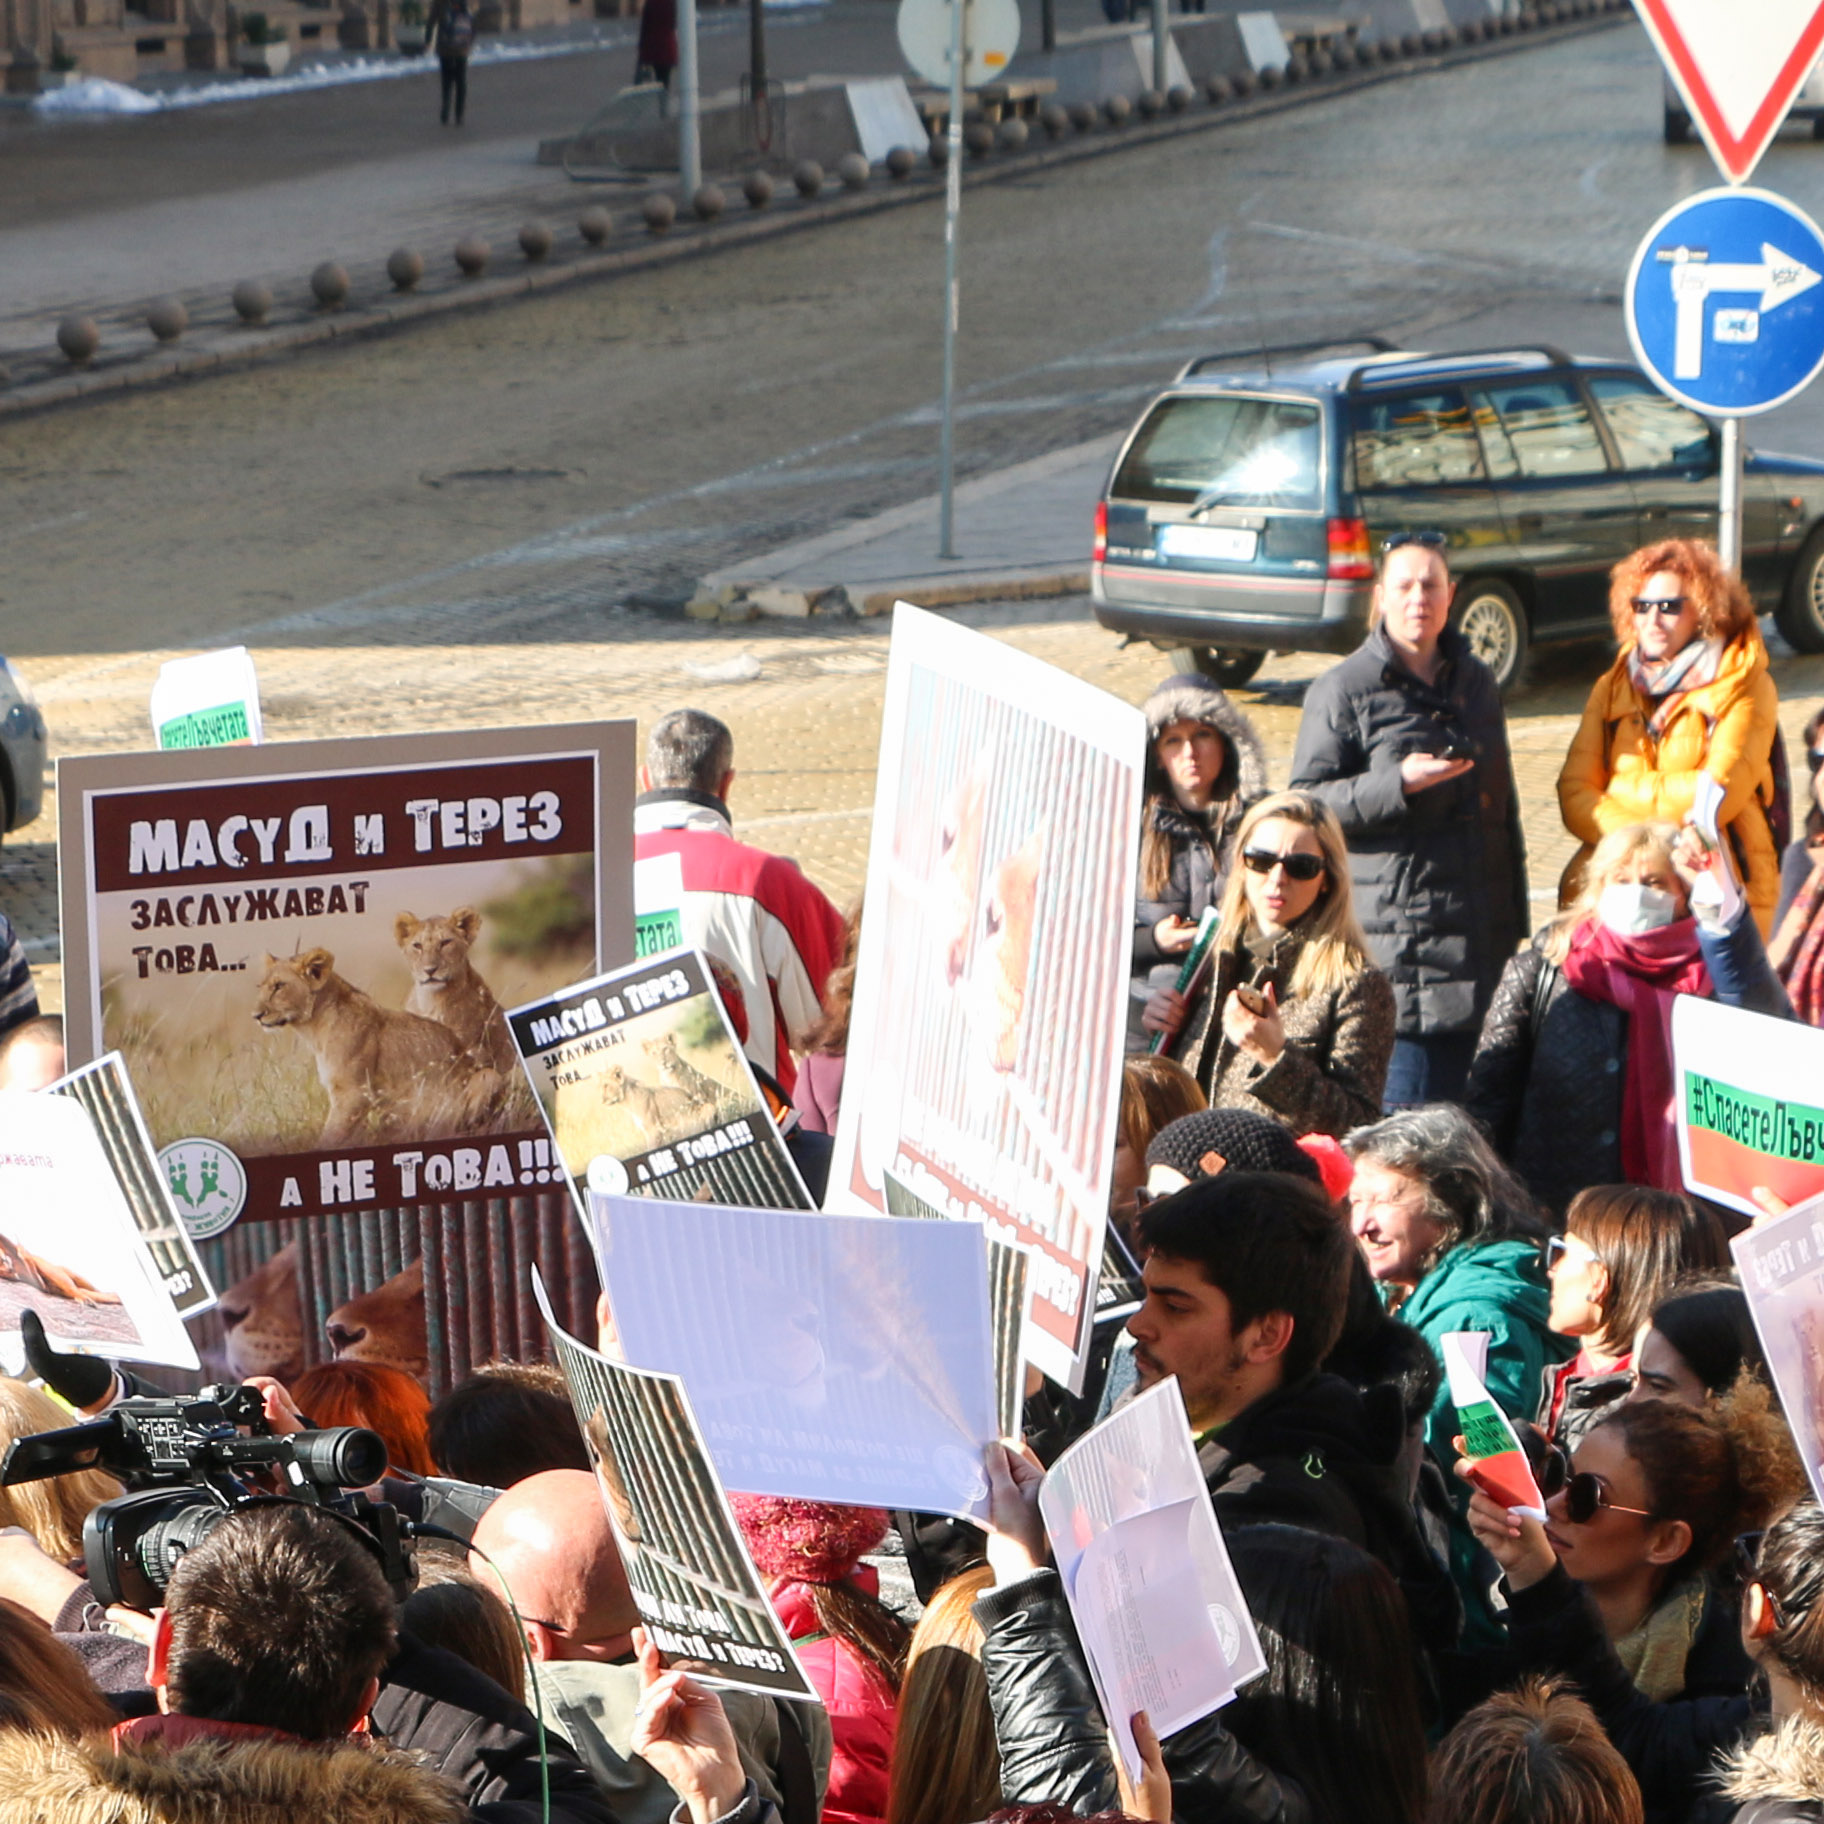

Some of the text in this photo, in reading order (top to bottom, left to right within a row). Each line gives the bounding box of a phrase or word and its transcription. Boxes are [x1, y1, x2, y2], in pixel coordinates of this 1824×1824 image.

[129, 804, 333, 876] МАСУД
[405, 790, 562, 856] ТЕРЕЗ
[130, 881, 371, 932] ЗАСЛУЖАВАТ
[131, 943, 247, 980] ТОВА...
[529, 998, 607, 1047] МАСУД
[623, 969, 691, 1014] ТЕРЕЗ
[542, 1029, 626, 1071] ЗАСЛУЖАВАТ
[647, 1150, 679, 1178] НЕ
[676, 1118, 755, 1168] ТОВА!!!
[319, 1158, 377, 1206] НЕ
[651, 1624, 714, 1661] МАСУД
[723, 1640, 787, 1673] ТЕРЕЗ?
